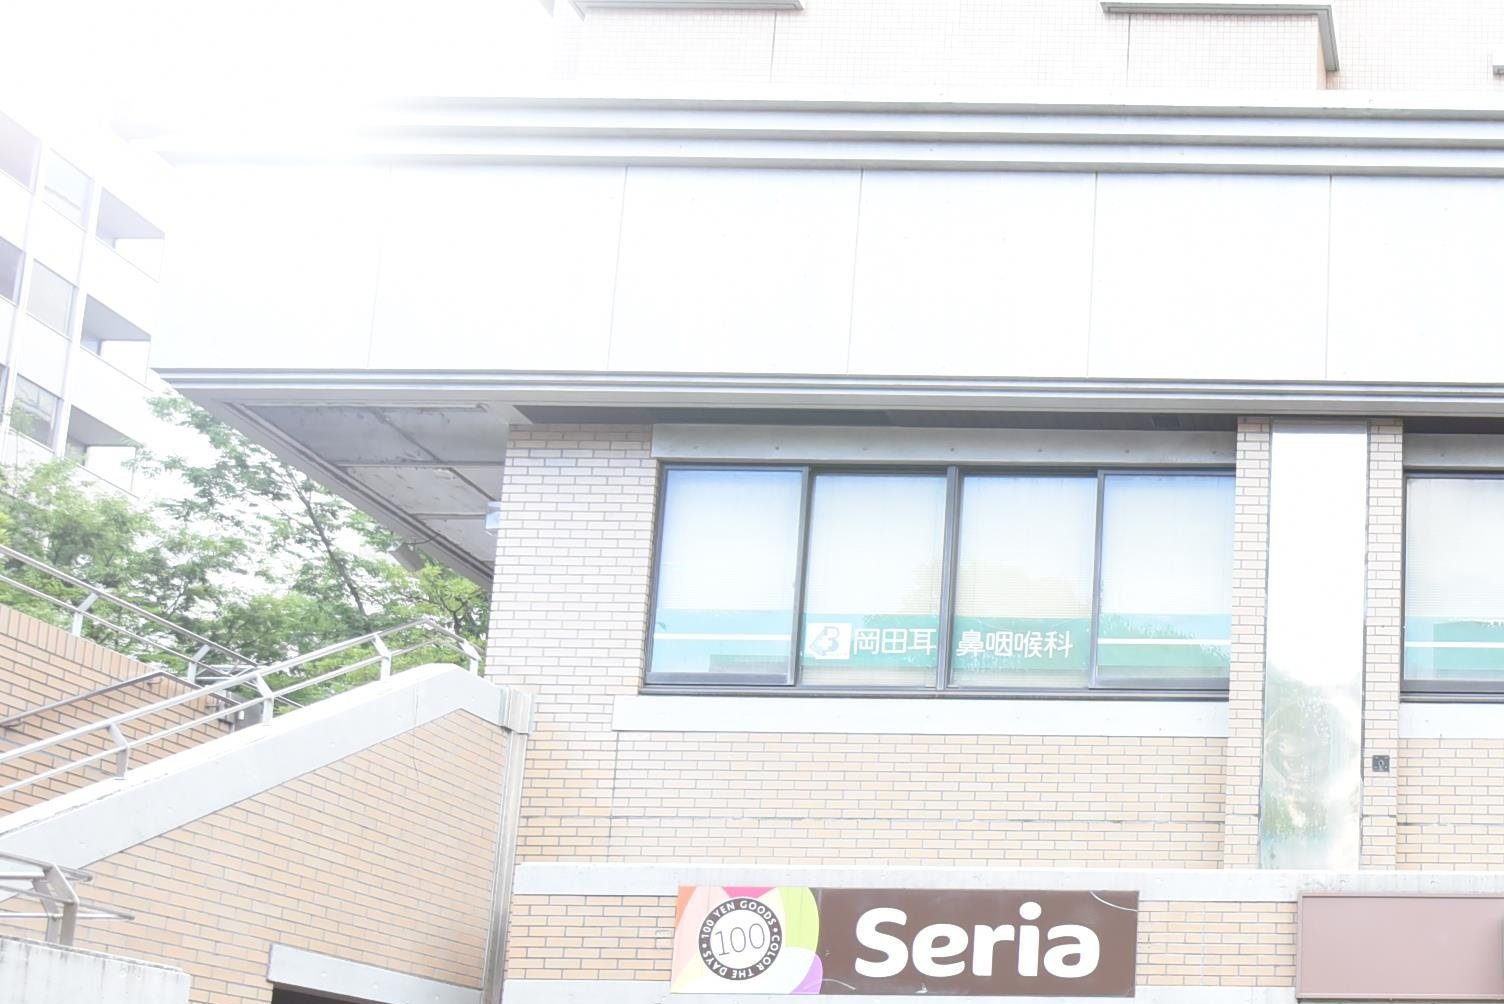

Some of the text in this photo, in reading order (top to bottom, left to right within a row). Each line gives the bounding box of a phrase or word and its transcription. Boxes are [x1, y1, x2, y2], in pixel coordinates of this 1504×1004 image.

[713, 902, 735, 919] YEN
[739, 900, 777, 926] GOODS
[702, 935, 780, 979] COLOR THE DAYS
[715, 923, 765, 956] 100
[855, 901, 1100, 979] Seria
